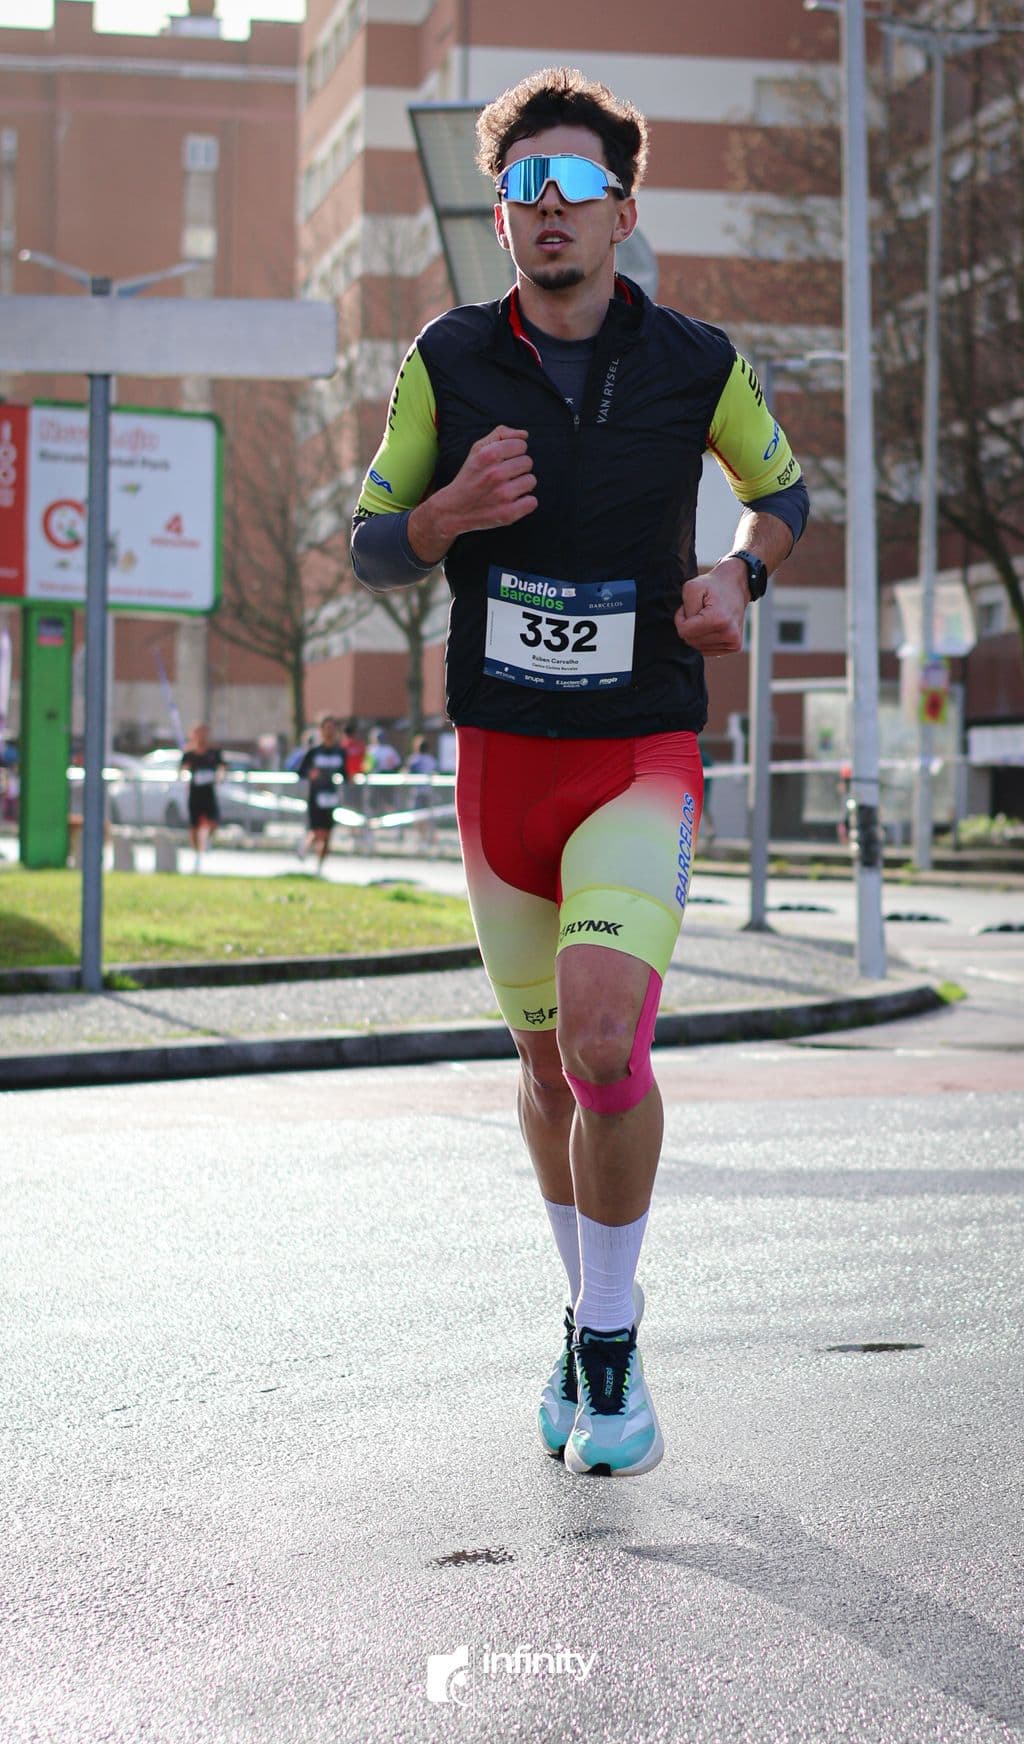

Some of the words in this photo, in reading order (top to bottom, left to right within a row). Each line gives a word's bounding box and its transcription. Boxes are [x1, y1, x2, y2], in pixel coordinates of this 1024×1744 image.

[597, 399, 611, 424] VAN
[604, 358, 620, 397] RYSEL
[499, 584, 565, 611] Barcelos
[500, 573, 558, 598] Duatlo
[519, 611, 599, 653] 332
[675, 792, 695, 909] BARCELOS
